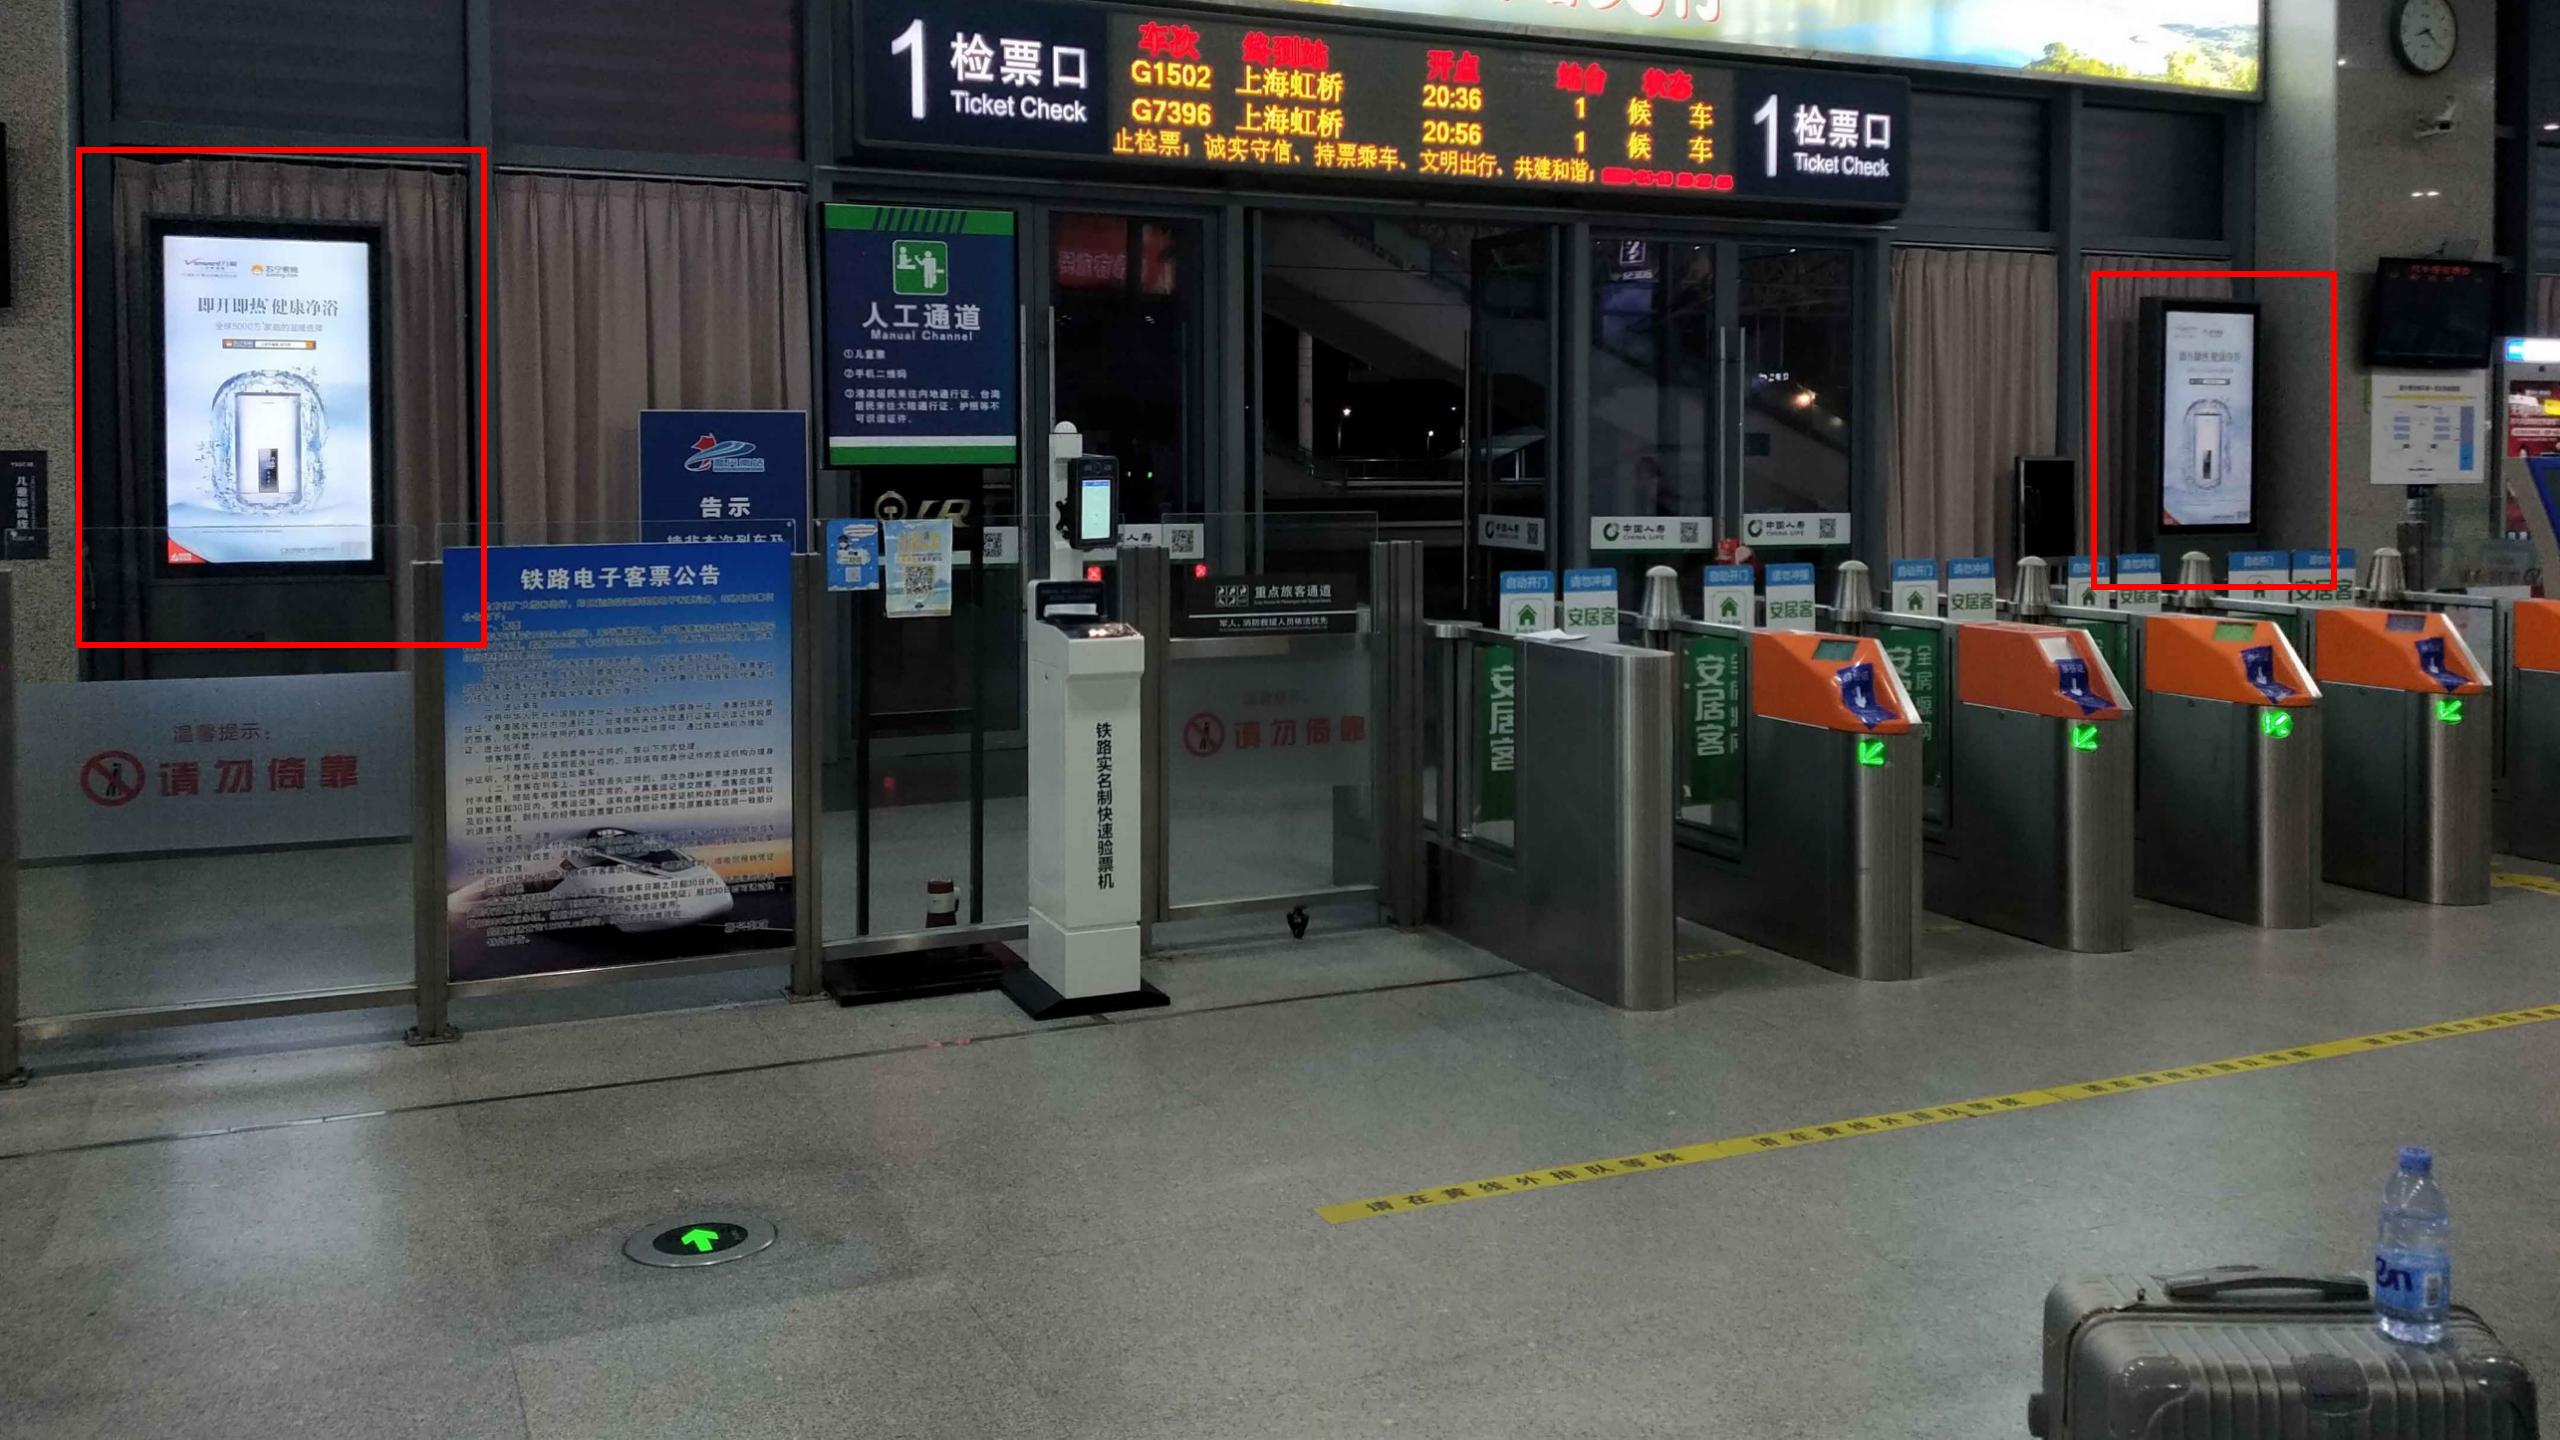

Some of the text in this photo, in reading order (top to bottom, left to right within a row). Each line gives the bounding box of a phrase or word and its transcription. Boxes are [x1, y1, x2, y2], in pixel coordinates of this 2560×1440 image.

[1139, 22, 1200, 60] 车次
[892, 18, 926, 119] 1
[951, 32, 1087, 89] 检票口
[951, 90, 1087, 122] Ticket Check
[1130, 60, 1212, 89] G1502
[1235, 65, 1344, 102] 上海虹桥
[1422, 84, 1482, 111] 20:36
[1574, 97, 1587, 119] 1
[1130, 98, 1212, 126] G7396
[1235, 103, 1344, 139] 上海虹桥
[1422, 120, 1482, 145] 20:56
[1574, 132, 1587, 153] 1
[1754, 94, 1778, 178] 1
[1793, 104, 1891, 150] 检票口
[1793, 152, 1890, 177] Ticket Check
[862, 302, 980, 330] 人工通道
[871, 329, 973, 341] Manual Channel
[700, 496, 750, 518] 告示
[521, 564, 721, 591] 铁路电子客票公告
[1255, 584, 1332, 599] 重点旅客通道
[1568, 606, 1616, 626] 安居客
[1769, 599, 1814, 619] 安居客
[1952, 592, 1993, 610] 安居客
[1696, 654, 1725, 756] 安居客
[159, 754, 358, 797] 请勿倚靠
[1096, 722, 1114, 889] 铁路实名制快速验票机
[1366, 1152, 1684, 1213] 请在黄线外排队等候
